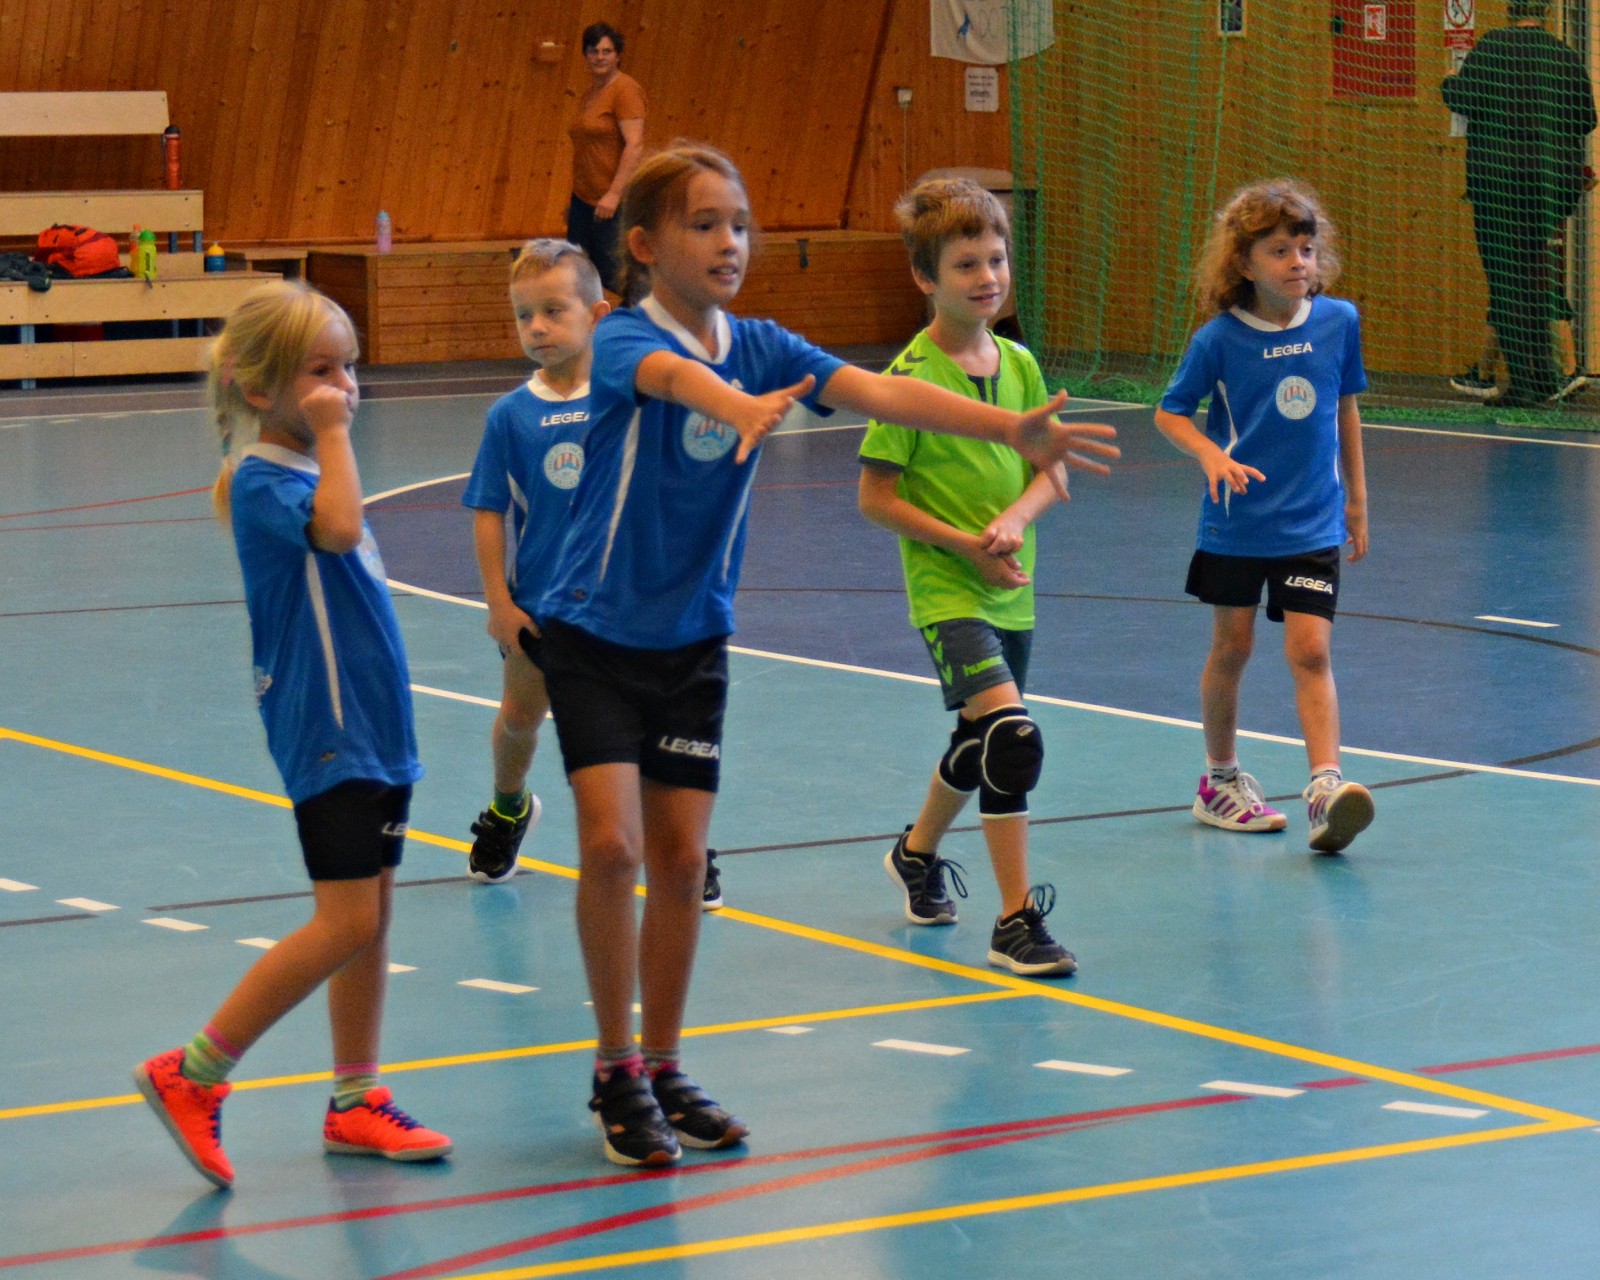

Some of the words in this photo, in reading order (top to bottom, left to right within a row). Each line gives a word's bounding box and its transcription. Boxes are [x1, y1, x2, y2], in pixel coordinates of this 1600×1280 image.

[1263, 342, 1313, 359] LEGEA
[1284, 575, 1333, 595] LEGEA
[658, 735, 720, 759] LEGEA
